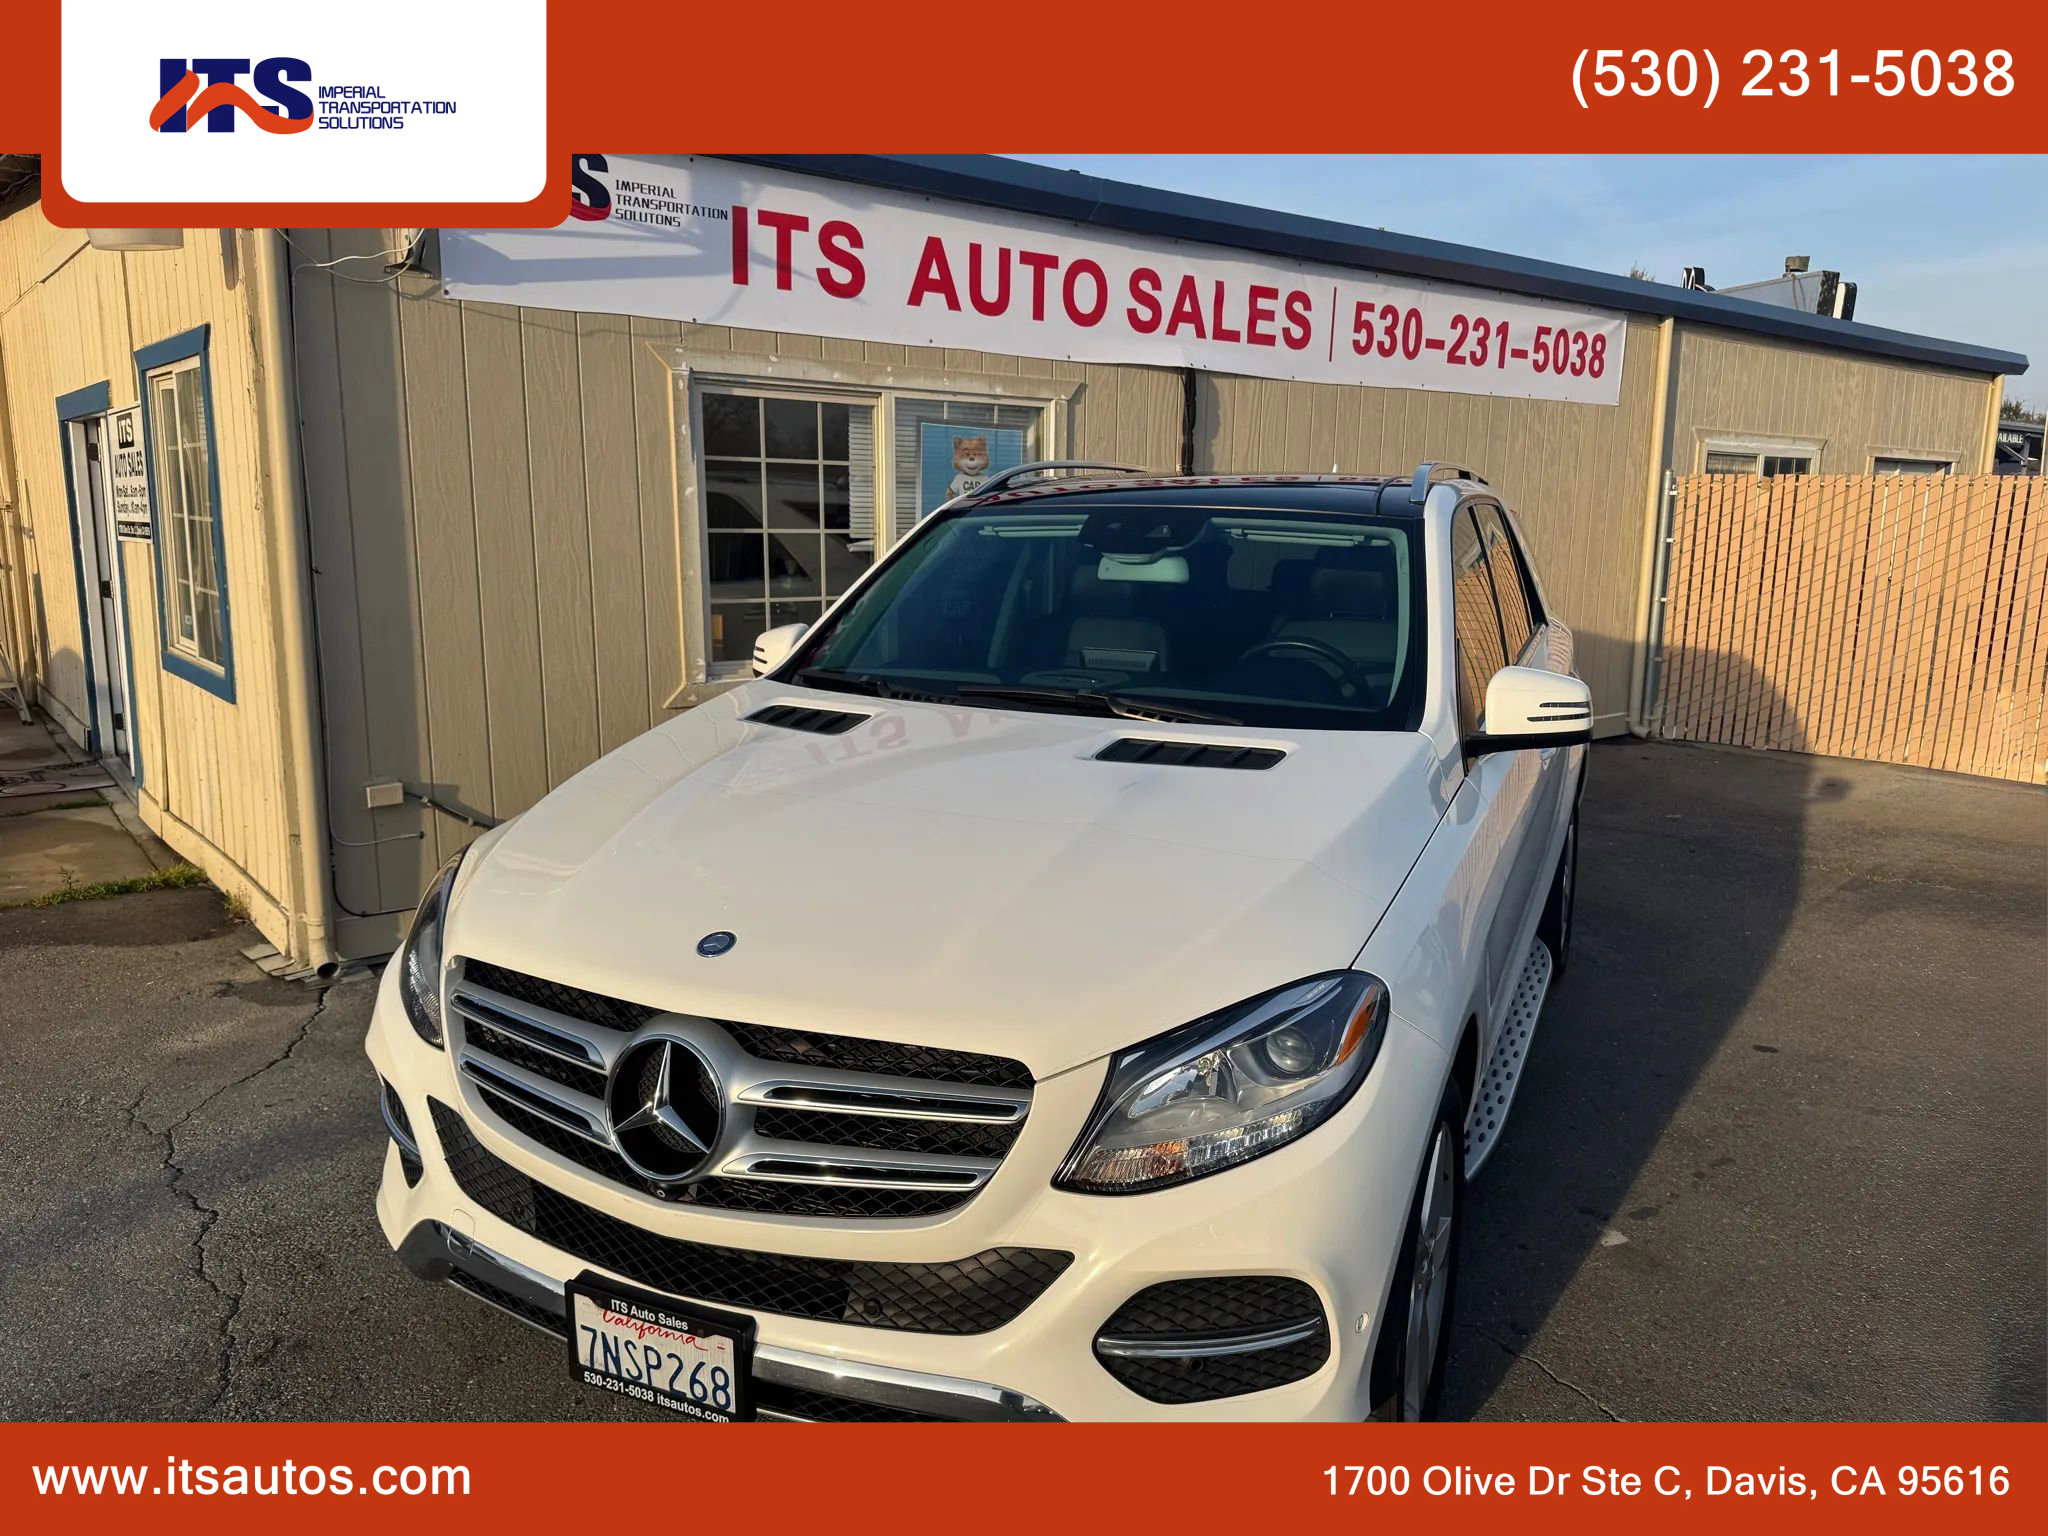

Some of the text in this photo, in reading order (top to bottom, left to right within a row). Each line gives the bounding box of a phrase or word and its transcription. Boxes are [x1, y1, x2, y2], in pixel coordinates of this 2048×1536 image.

[615, 179, 678, 200] IMPERIAL
[615, 193, 729, 221] TRANSPORTATION
[615, 208, 682, 228] SOLUTONS
[732, 205, 1607, 379] ITS AUTO SALES 530-231-5038
[118, 417, 134, 444] ITS
[1998, 432, 2024, 444] AILABLE
[611, 1299, 628, 1314] ITS
[630, 1304, 656, 1323] Auto
[658, 1314, 689, 1331] Sales
[602, 1309, 709, 1352] California
[581, 1324, 732, 1411] 7NSP268
[584, 1371, 730, 1423] 530-231-5038 itsautos.com
